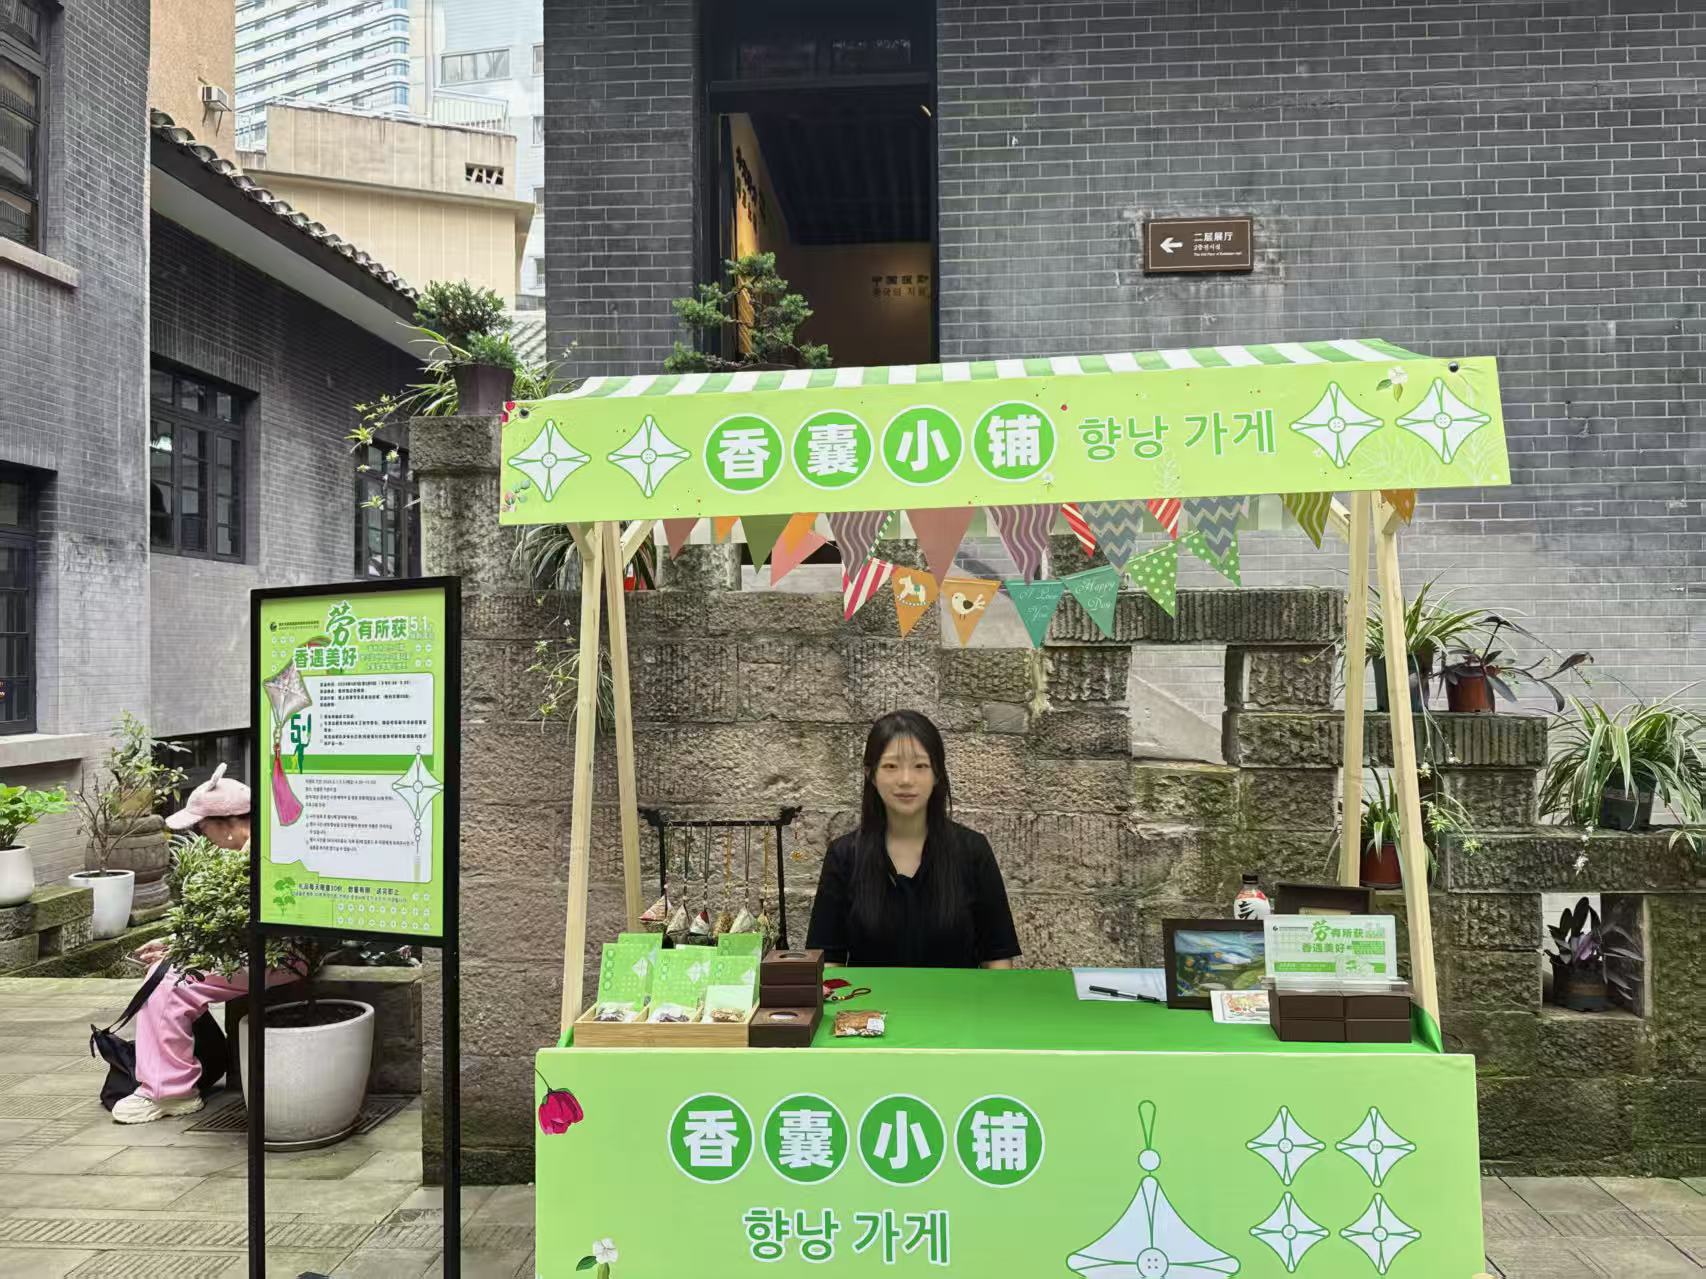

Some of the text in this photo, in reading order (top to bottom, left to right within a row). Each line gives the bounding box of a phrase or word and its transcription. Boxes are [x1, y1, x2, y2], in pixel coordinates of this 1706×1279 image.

[1194, 231, 1233, 241] 二层展厅
[718, 414, 1041, 479] 香囊小铺
[1078, 408, 1277, 460] 향낭 가게
[1075, 578, 1115, 594] Happy
[683, 1109, 1029, 1171] 香囊小铺
[744, 1208, 950, 1266] 향낭 가게
